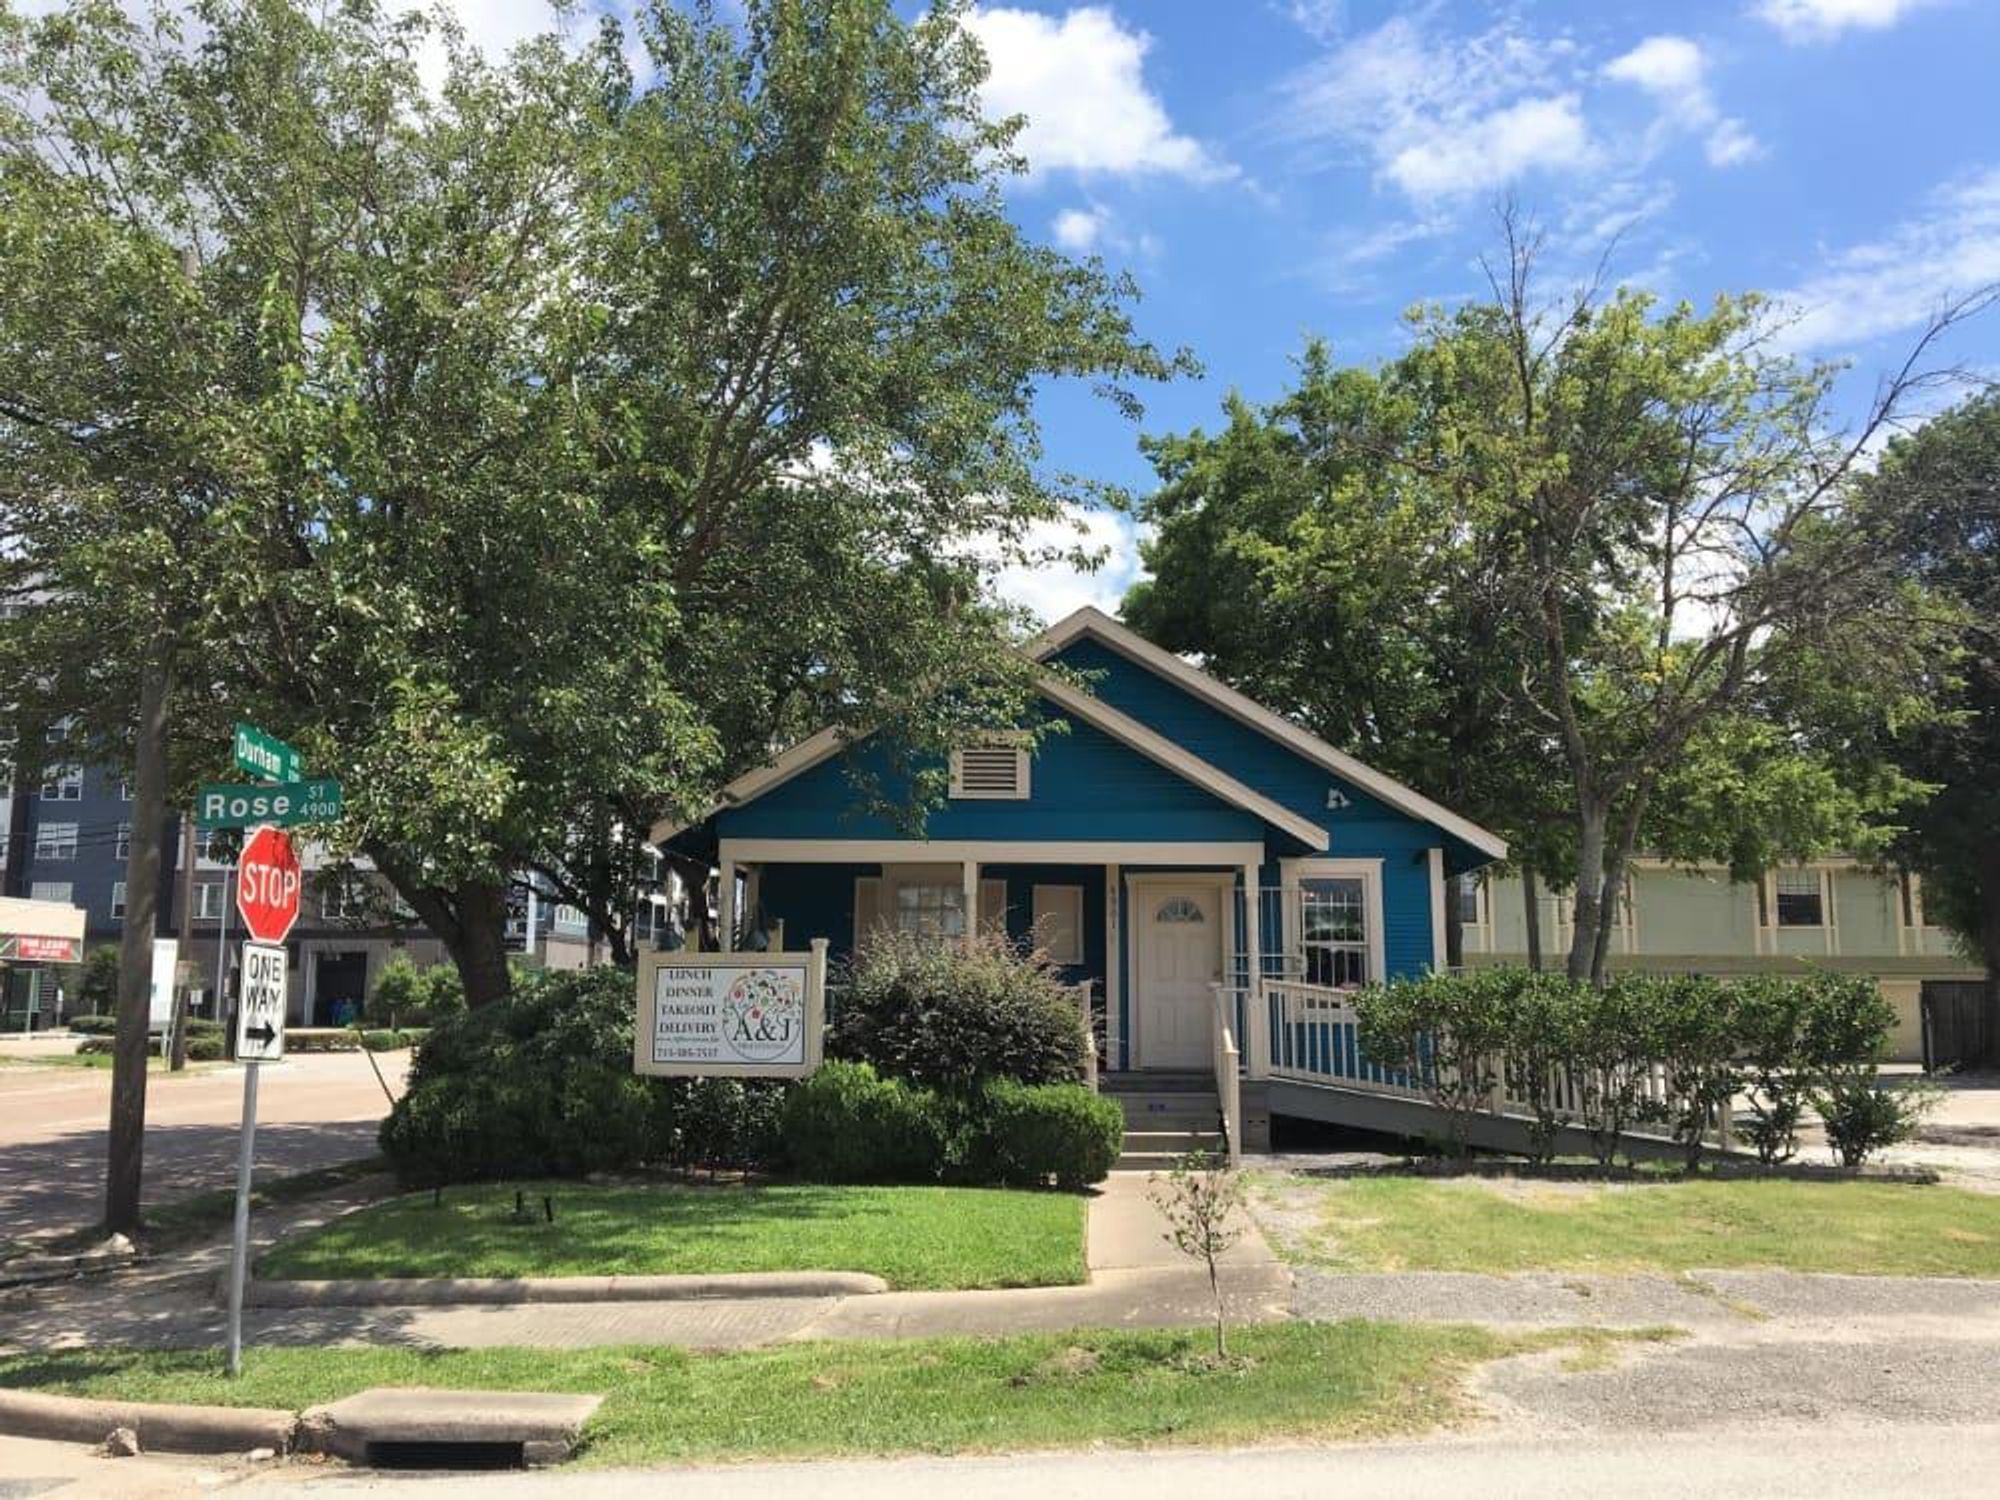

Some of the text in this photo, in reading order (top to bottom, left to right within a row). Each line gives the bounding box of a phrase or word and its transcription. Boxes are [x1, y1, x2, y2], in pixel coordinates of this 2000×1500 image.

[238, 732, 281, 775] Durham
[308, 786, 325, 799] ST
[205, 794, 290, 819] Rose
[300, 802, 336, 816] 4900
[243, 863, 296, 908] STOP
[249, 954, 281, 981] ONE
[669, 970, 712, 980] LUNCH
[247, 985, 281, 1014] WAY
[666, 987, 713, 998] DINNER
[661, 1004, 716, 1015] TAKEOUT
[659, 1022, 717, 1033] DELIVERY
[732, 1018, 791, 1041] A&J
